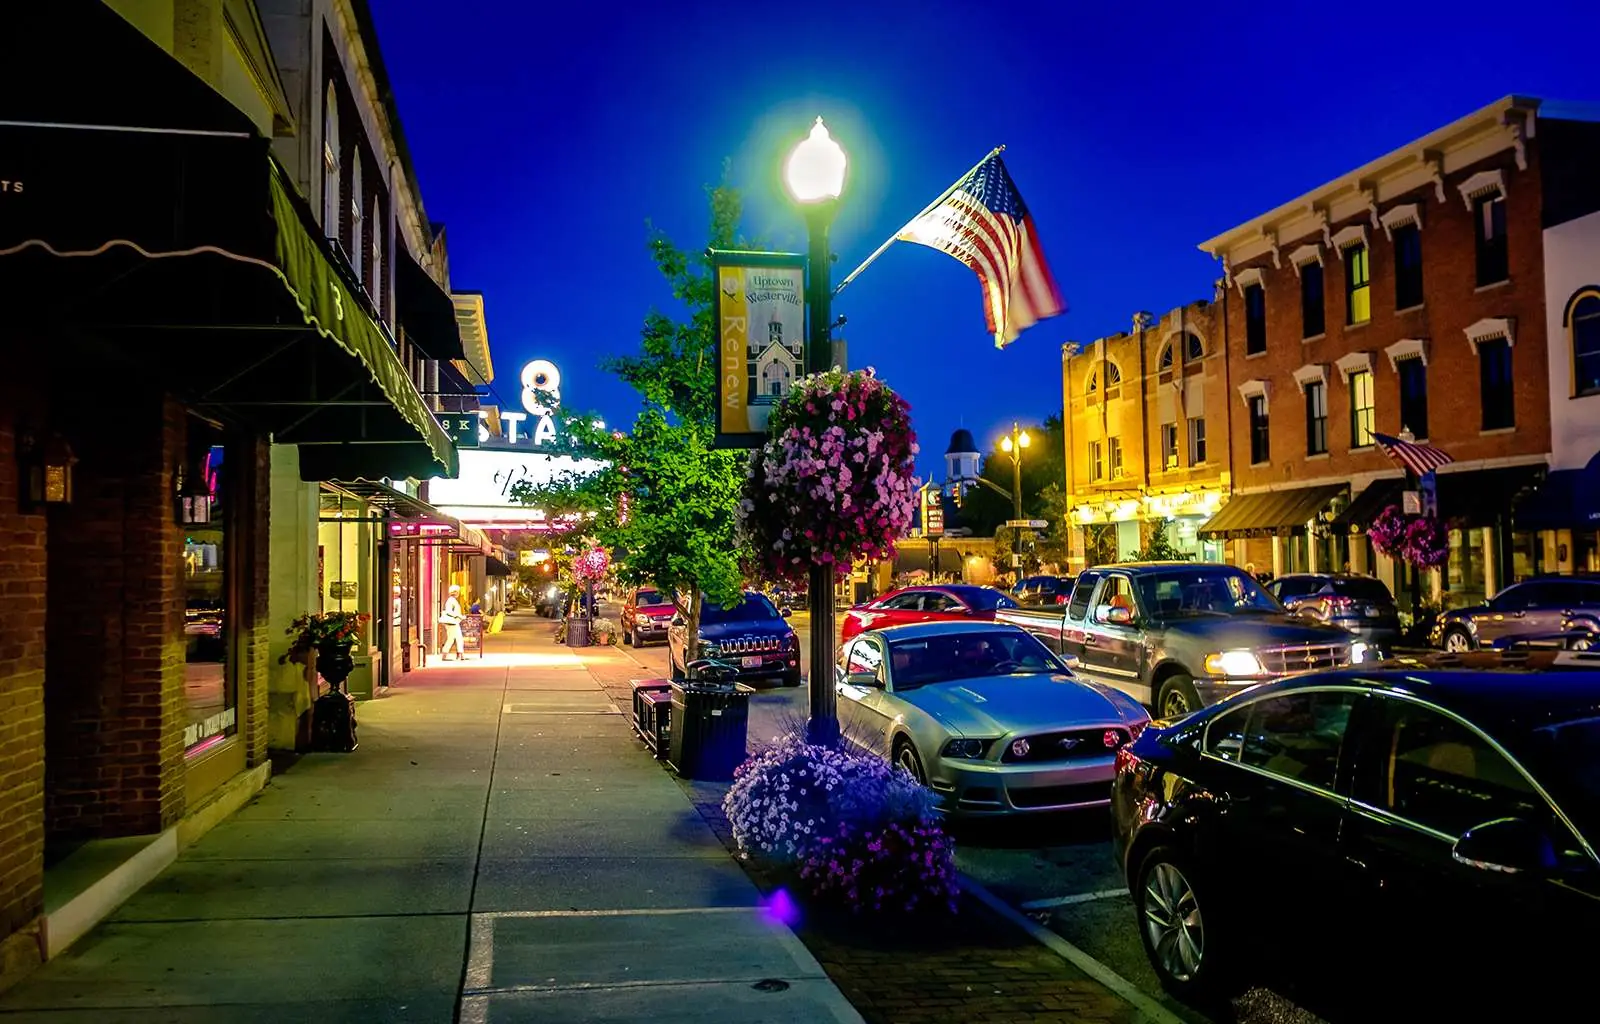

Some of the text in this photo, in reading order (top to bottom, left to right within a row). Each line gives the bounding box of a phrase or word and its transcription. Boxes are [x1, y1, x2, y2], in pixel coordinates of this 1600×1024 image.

[752, 275, 795, 288] Uptown
[745, 290, 803, 306] Westerville
[723, 315, 746, 410] Renew
